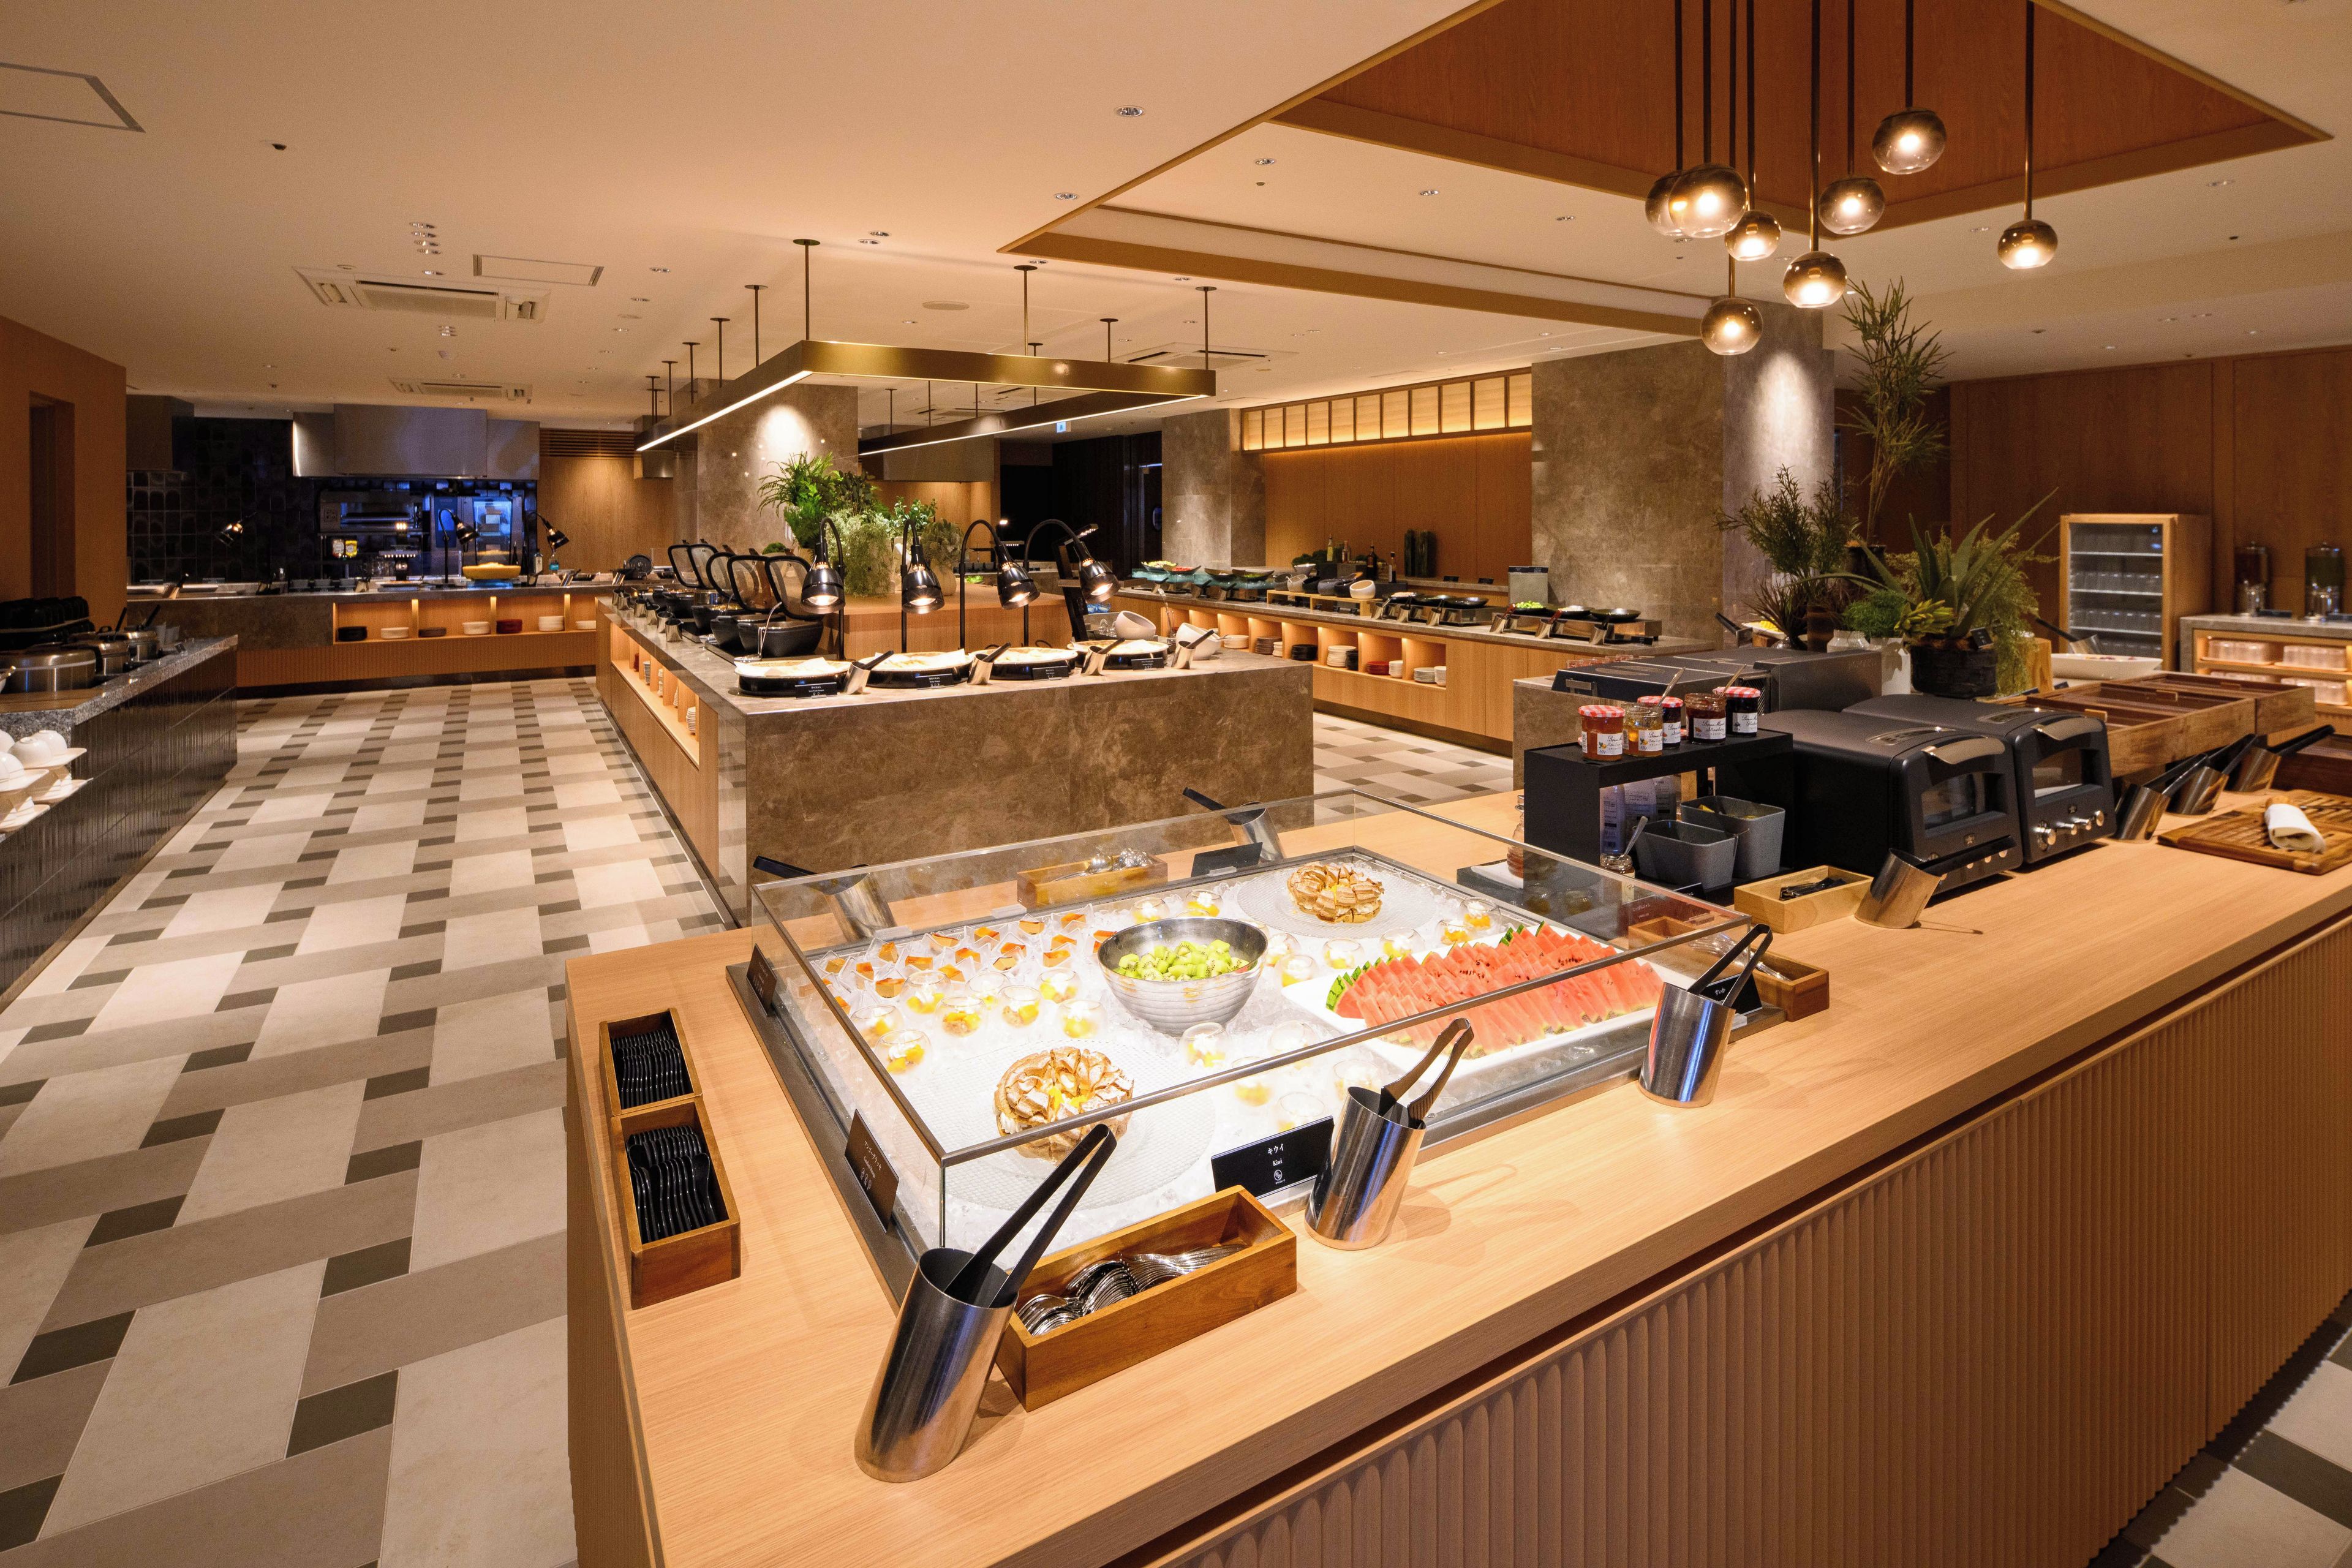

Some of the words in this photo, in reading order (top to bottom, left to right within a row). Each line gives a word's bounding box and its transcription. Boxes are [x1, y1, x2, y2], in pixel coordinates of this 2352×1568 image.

[1714, 987, 1726, 996] すいか
[1268, 1144, 1283, 1155] キウイ
